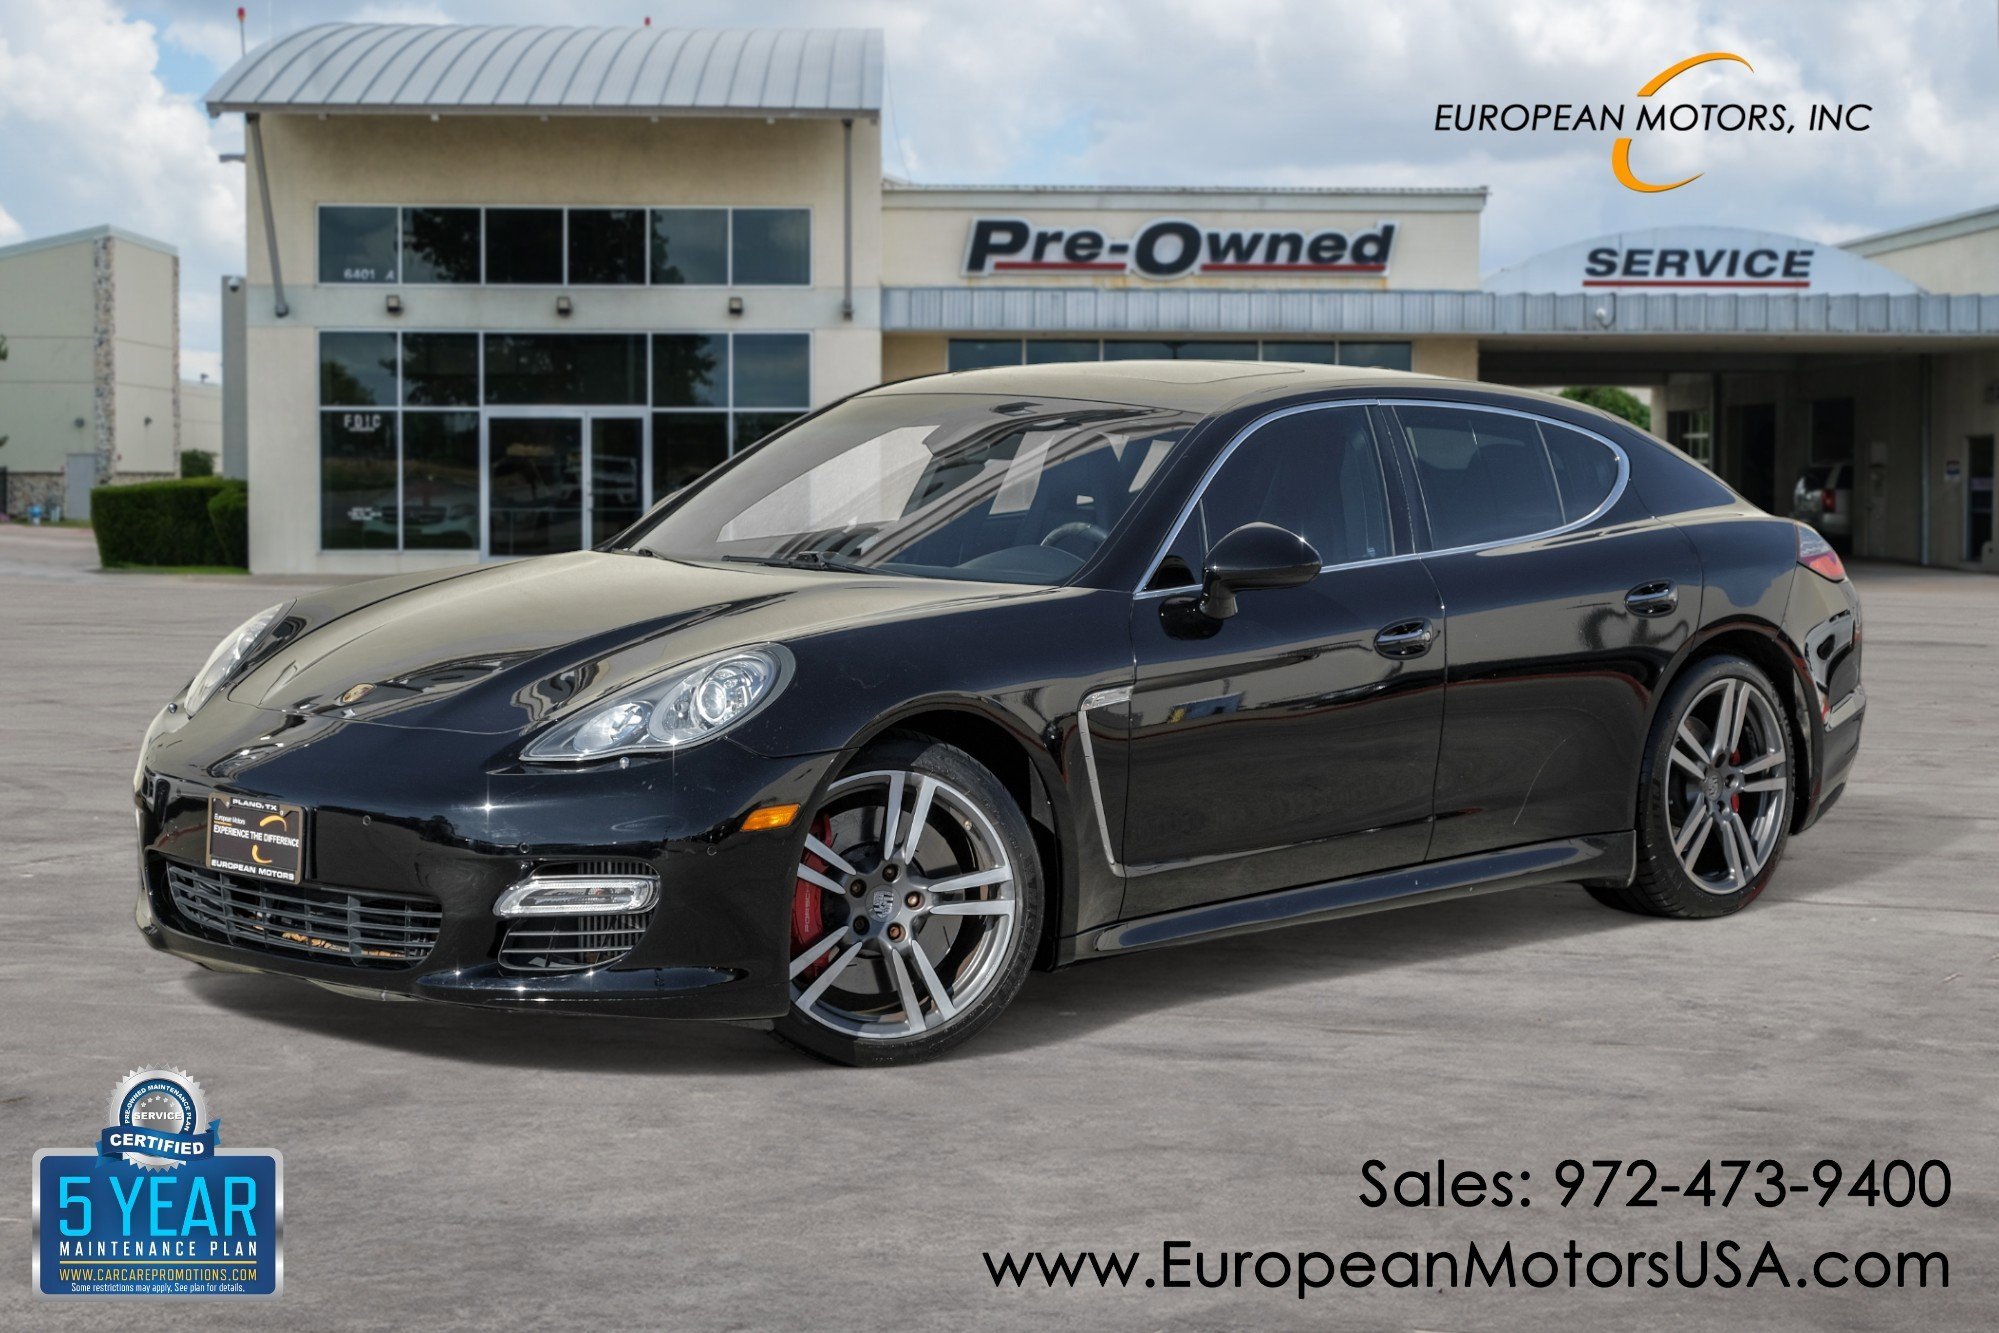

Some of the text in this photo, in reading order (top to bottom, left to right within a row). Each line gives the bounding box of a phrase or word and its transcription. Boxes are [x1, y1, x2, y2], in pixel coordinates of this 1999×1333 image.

[966, 219, 1396, 276] Pre-Owned
[343, 268, 376, 280] 6401
[1584, 248, 1815, 278] SERVICE
[264, 803, 277, 811] TX
[213, 824, 299, 848] EXPERIENCE THE DIFFERENCE
[211, 858, 295, 881] EUROPEAN MOTORS
